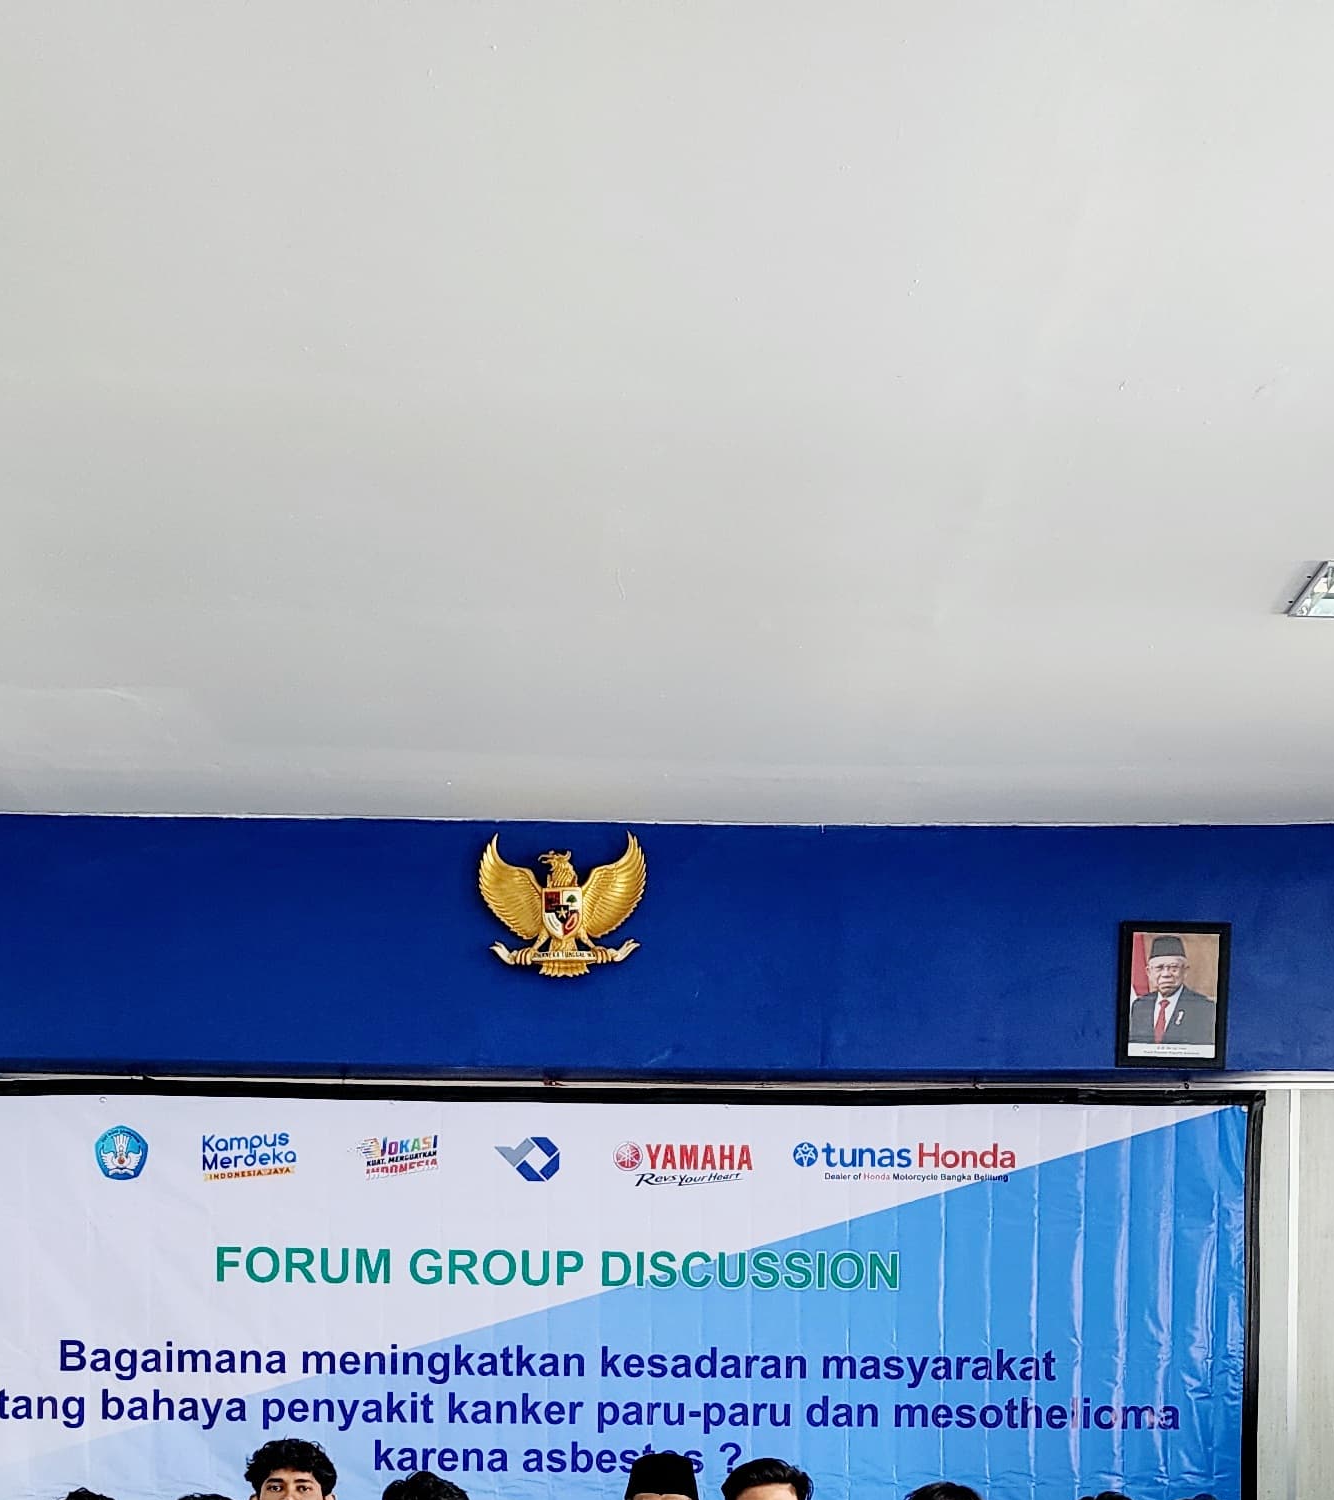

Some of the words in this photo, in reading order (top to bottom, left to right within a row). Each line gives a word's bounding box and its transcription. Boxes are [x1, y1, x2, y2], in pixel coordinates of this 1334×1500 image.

[202, 1132, 290, 1153] Kampus
[821, 1142, 912, 1168] tunas
[918, 1142, 1016, 1169] Honda
[202, 1147, 297, 1170] Merdeka
[646, 1144, 753, 1170] YAMAHA
[209, 1169, 263, 1180] INDONESIA
[267, 1167, 292, 1176] JAYA
[635, 1173, 677, 1187] Revs
[678, 1173, 707, 1187] Your
[708, 1172, 743, 1183] Heart
[824, 1172, 851, 1181] Dealer
[853, 1172, 862, 1181] of
[863, 1172, 891, 1181] Honda
[940, 1173, 972, 1183] Bangka
[216, 1246, 391, 1284] FORUM
[409, 1248, 584, 1287] GROUP
[601, 1250, 900, 1290] DISCUSSION
[60, 1339, 286, 1381] Bagaimana
[302, 1343, 585, 1385] meningkatkan
[601, 1345, 807, 1379] kesadaran
[822, 1348, 1057, 1389] masyarakat
[101, 1388, 247, 1430] bahaya
[262, 1391, 434, 1432] penyakit
[448, 1391, 584, 1425] kanker
[597, 1401, 791, 1435] paru-paru
[806, 1395, 879, 1428] dan
[374, 1439, 508, 1473] karena
[719, 1442, 742, 1474] ?
